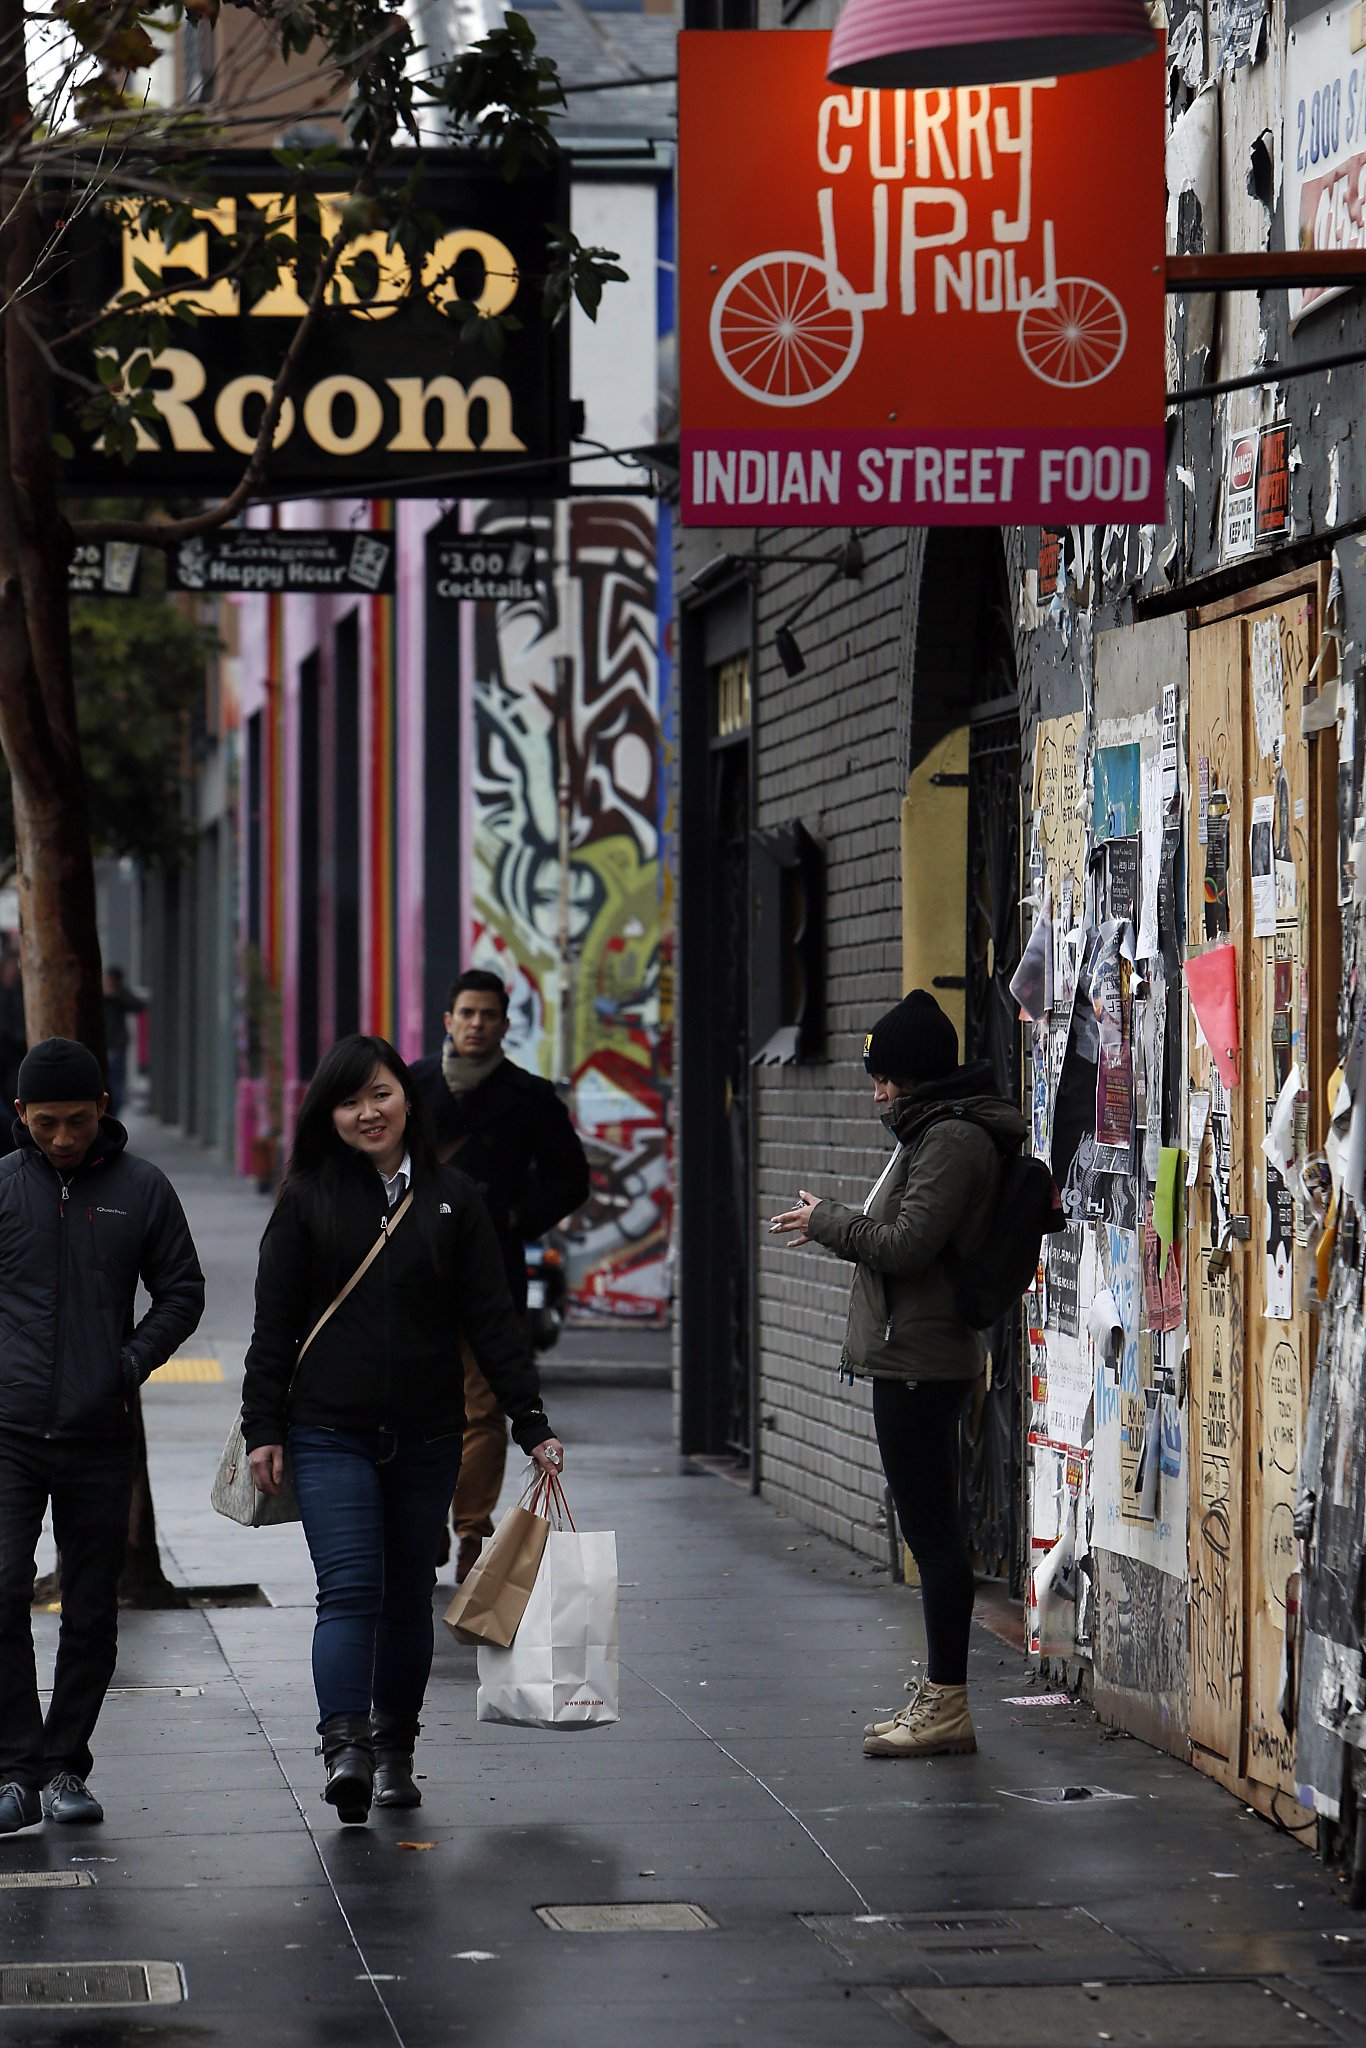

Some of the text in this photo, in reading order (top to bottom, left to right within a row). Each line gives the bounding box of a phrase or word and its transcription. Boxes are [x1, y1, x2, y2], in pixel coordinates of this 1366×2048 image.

[817, 76, 1058, 242] CURRY
[1297, 68, 1366, 175] 2,000 S/
[817, 183, 968, 315] UP
[934, 219, 1058, 314] NOW
[92, 346, 529, 456] Room
[692, 446, 1151, 506] INDIAN STREET FOOD
[210, 561, 348, 588] Happy Hour
[436, 578, 534, 598] Cocktails
